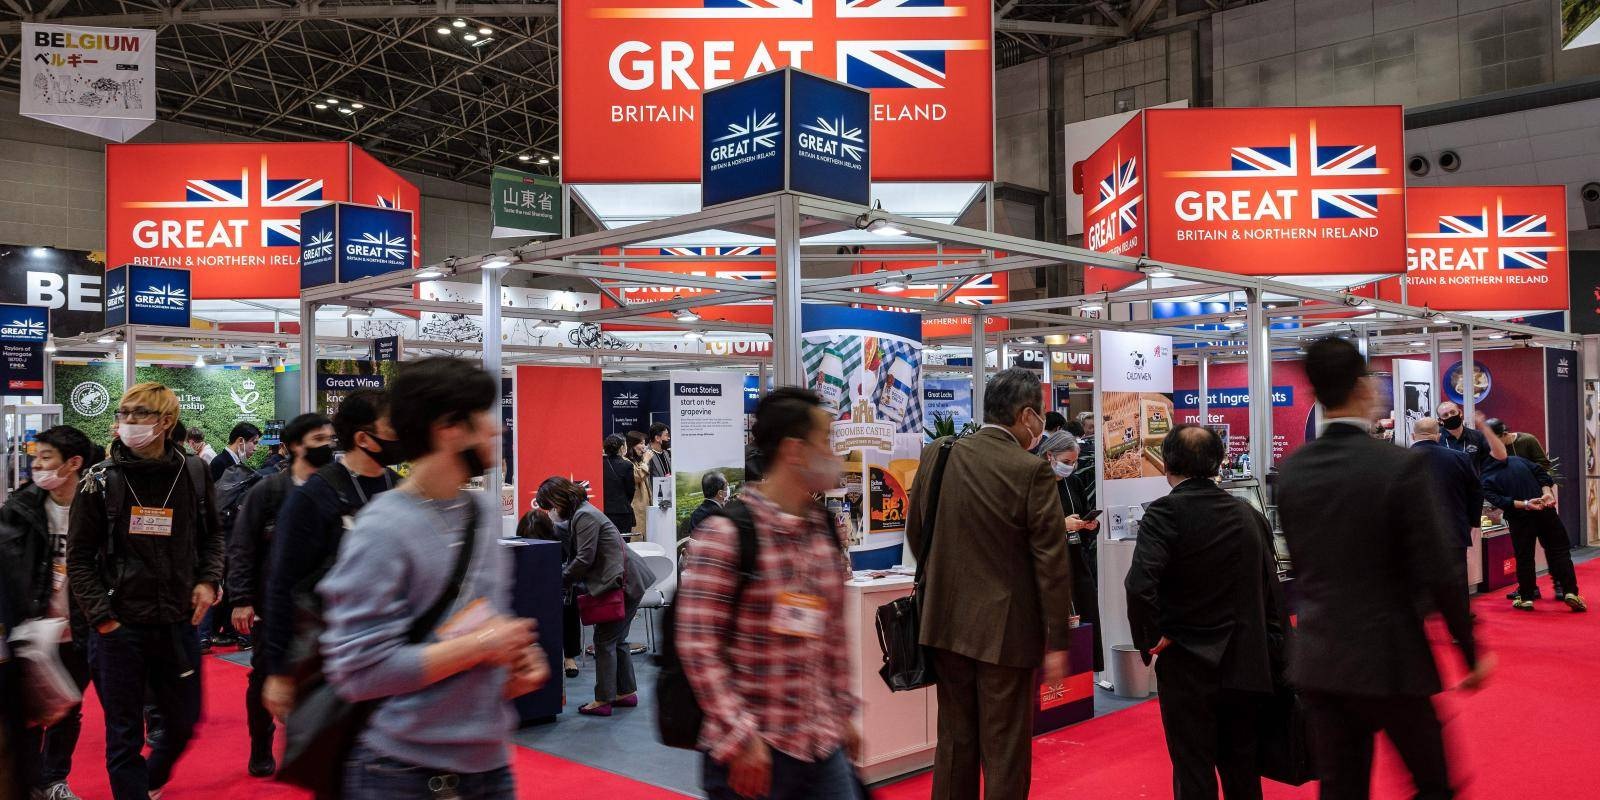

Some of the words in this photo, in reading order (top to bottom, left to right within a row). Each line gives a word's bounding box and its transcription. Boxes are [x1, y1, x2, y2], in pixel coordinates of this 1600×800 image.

[34, 31, 140, 52] BELGIUM
[34, 52, 98, 67] ベルギー
[611, 104, 695, 123] BRITAIN
[874, 104, 947, 121] ELAND
[710, 139, 750, 162] GREAT
[798, 132, 839, 156] GREAT
[710, 162, 727, 171] BRITAIN
[731, 155, 756, 166] NORTHERN
[756, 150, 776, 161] IRELAND
[798, 149, 816, 159] BRITAIN
[820, 155, 843, 166] NORTHERN
[843, 159, 862, 171] IRELAND
[503, 187, 553, 211] 山東省
[1174, 189, 1299, 221] GREAT
[132, 219, 248, 249] GREAT
[1088, 210, 1118, 251] GREAT
[1177, 229, 1229, 241] BRITAIN
[1232, 229, 1242, 241] &
[1244, 228, 1318, 240] NORTHERN
[1321, 226, 1379, 239] IRELAND
[346, 244, 383, 258] GREAT
[1121, 235, 1138, 253] IRELAND
[133, 256, 182, 266] BRITAIN
[185, 256, 194, 267] &
[196, 255, 265, 267] NORTHERN
[270, 255, 301, 266] IRELA
[303, 247, 321, 261] GREAT
[1407, 247, 1489, 271] GREAT
[1439, 276, 1447, 285] &
[1449, 275, 1503, 285] NORTHERN
[1506, 275, 1549, 284] IRELAND
[135, 294, 166, 305] GREAT
[960, 317, 994, 326] IREND
[1, 327, 28, 336] GREAT
[3, 345, 24, 353] Taylors
[326, 377, 355, 388] Great
[356, 378, 380, 388] Wine
[680, 385, 699, 394] Great
[699, 385, 720, 394] Stories
[186, 394, 201, 402] Tea
[326, 393, 345, 403] kno
[1184, 393, 1217, 405] Grat
[680, 408, 712, 416] grapevine
[865, 426, 891, 438] CASTLE
